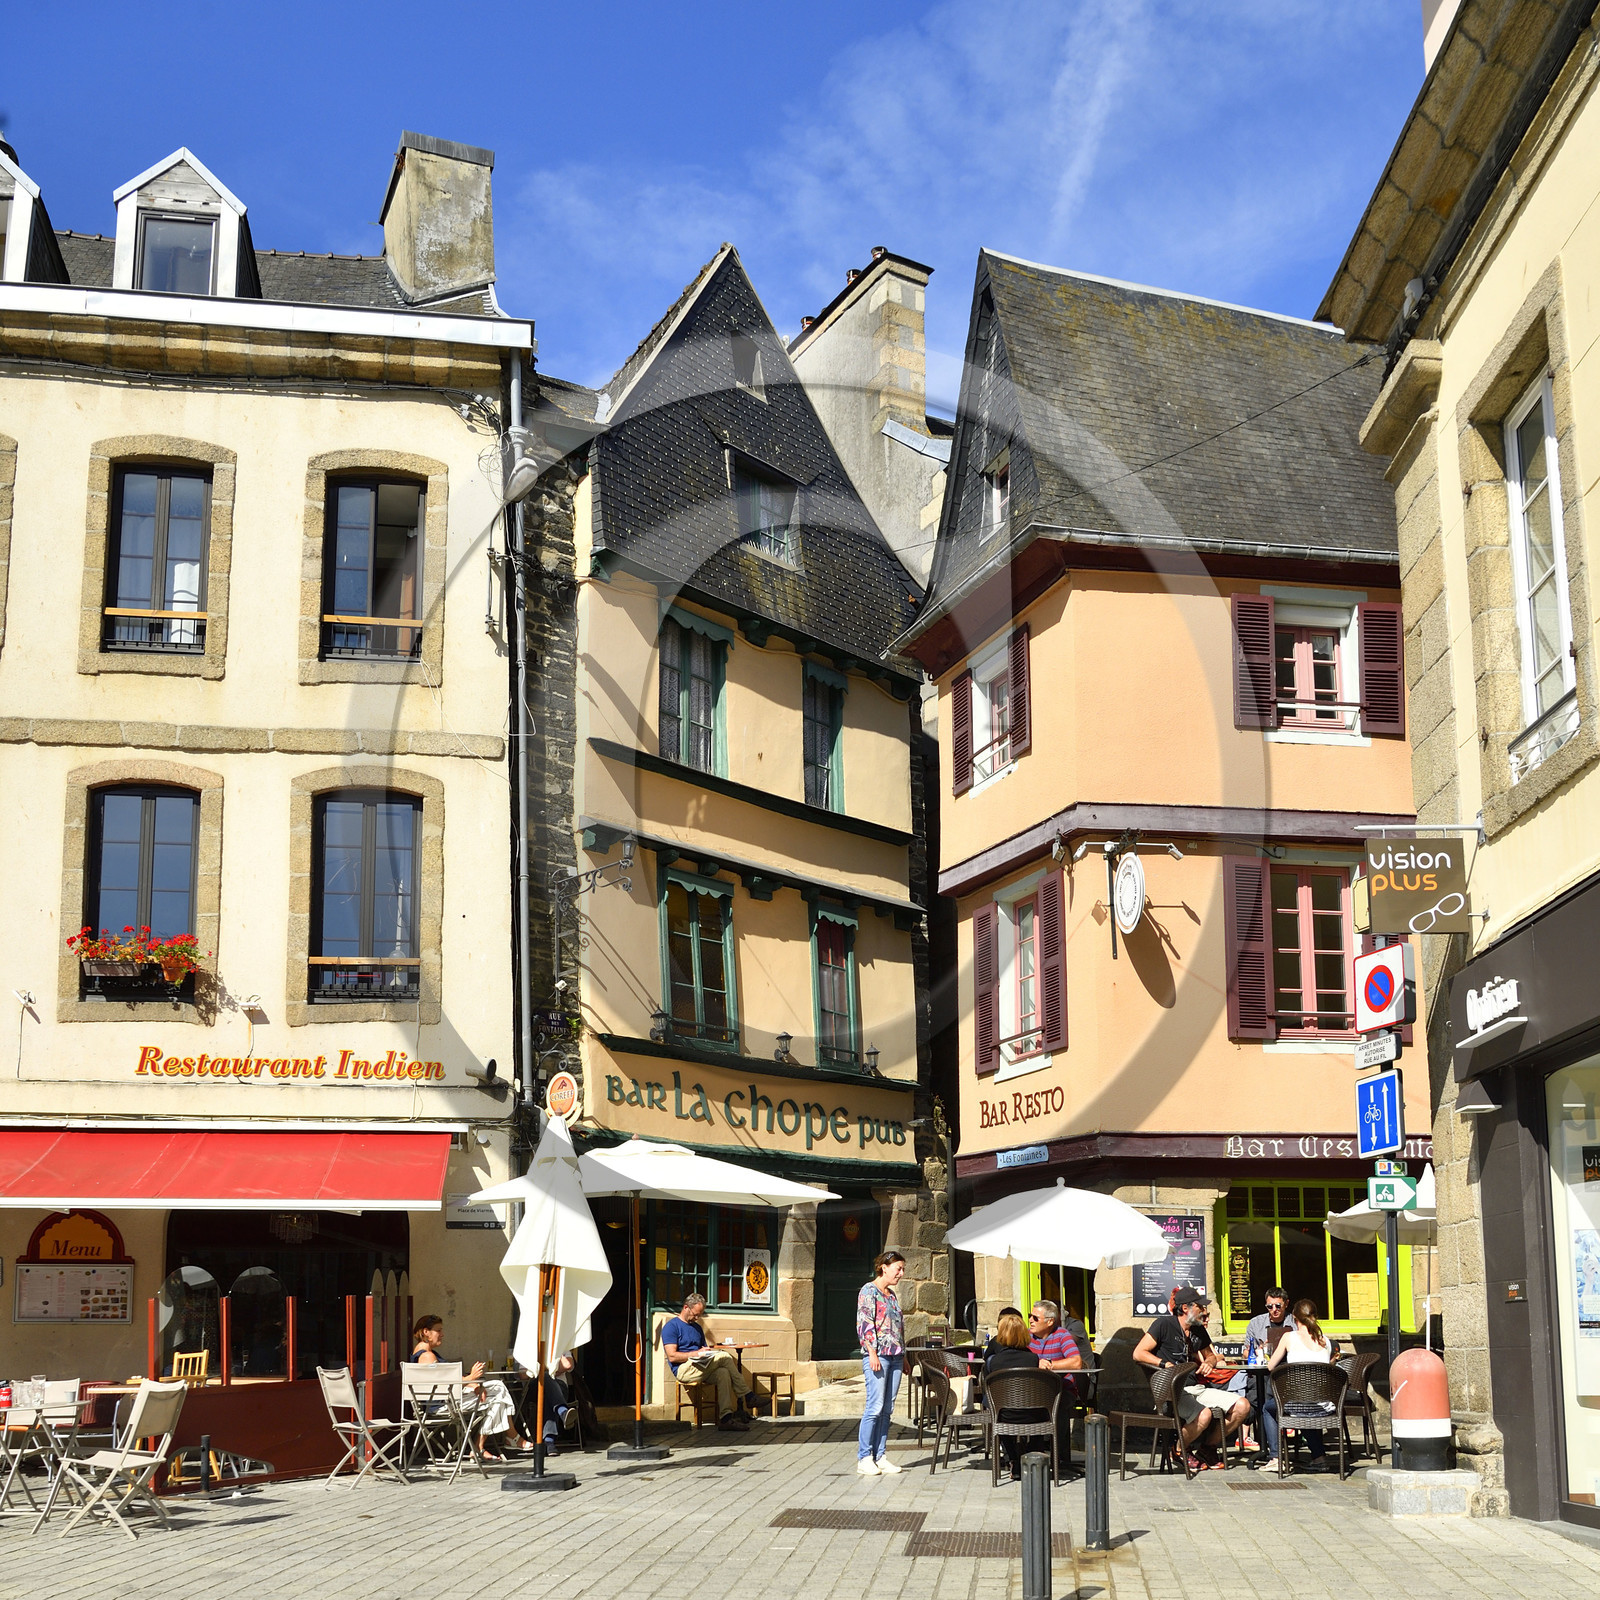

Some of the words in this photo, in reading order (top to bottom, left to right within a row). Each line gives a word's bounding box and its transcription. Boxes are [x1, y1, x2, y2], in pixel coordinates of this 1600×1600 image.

[1369, 845, 1452, 870] vision
[1371, 870, 1438, 897] plus
[549, 1012, 561, 1020] RUE
[1358, 1043, 1373, 1051] ARRET
[1373, 1037, 1391, 1046] MINUTES
[134, 1046, 327, 1079] Restaurant
[333, 1049, 446, 1080] Indien
[1225, 1135, 1285, 1158] Bar
[51, 1239, 102, 1257] Menu
[1214, 1345, 1228, 1355] Rue
